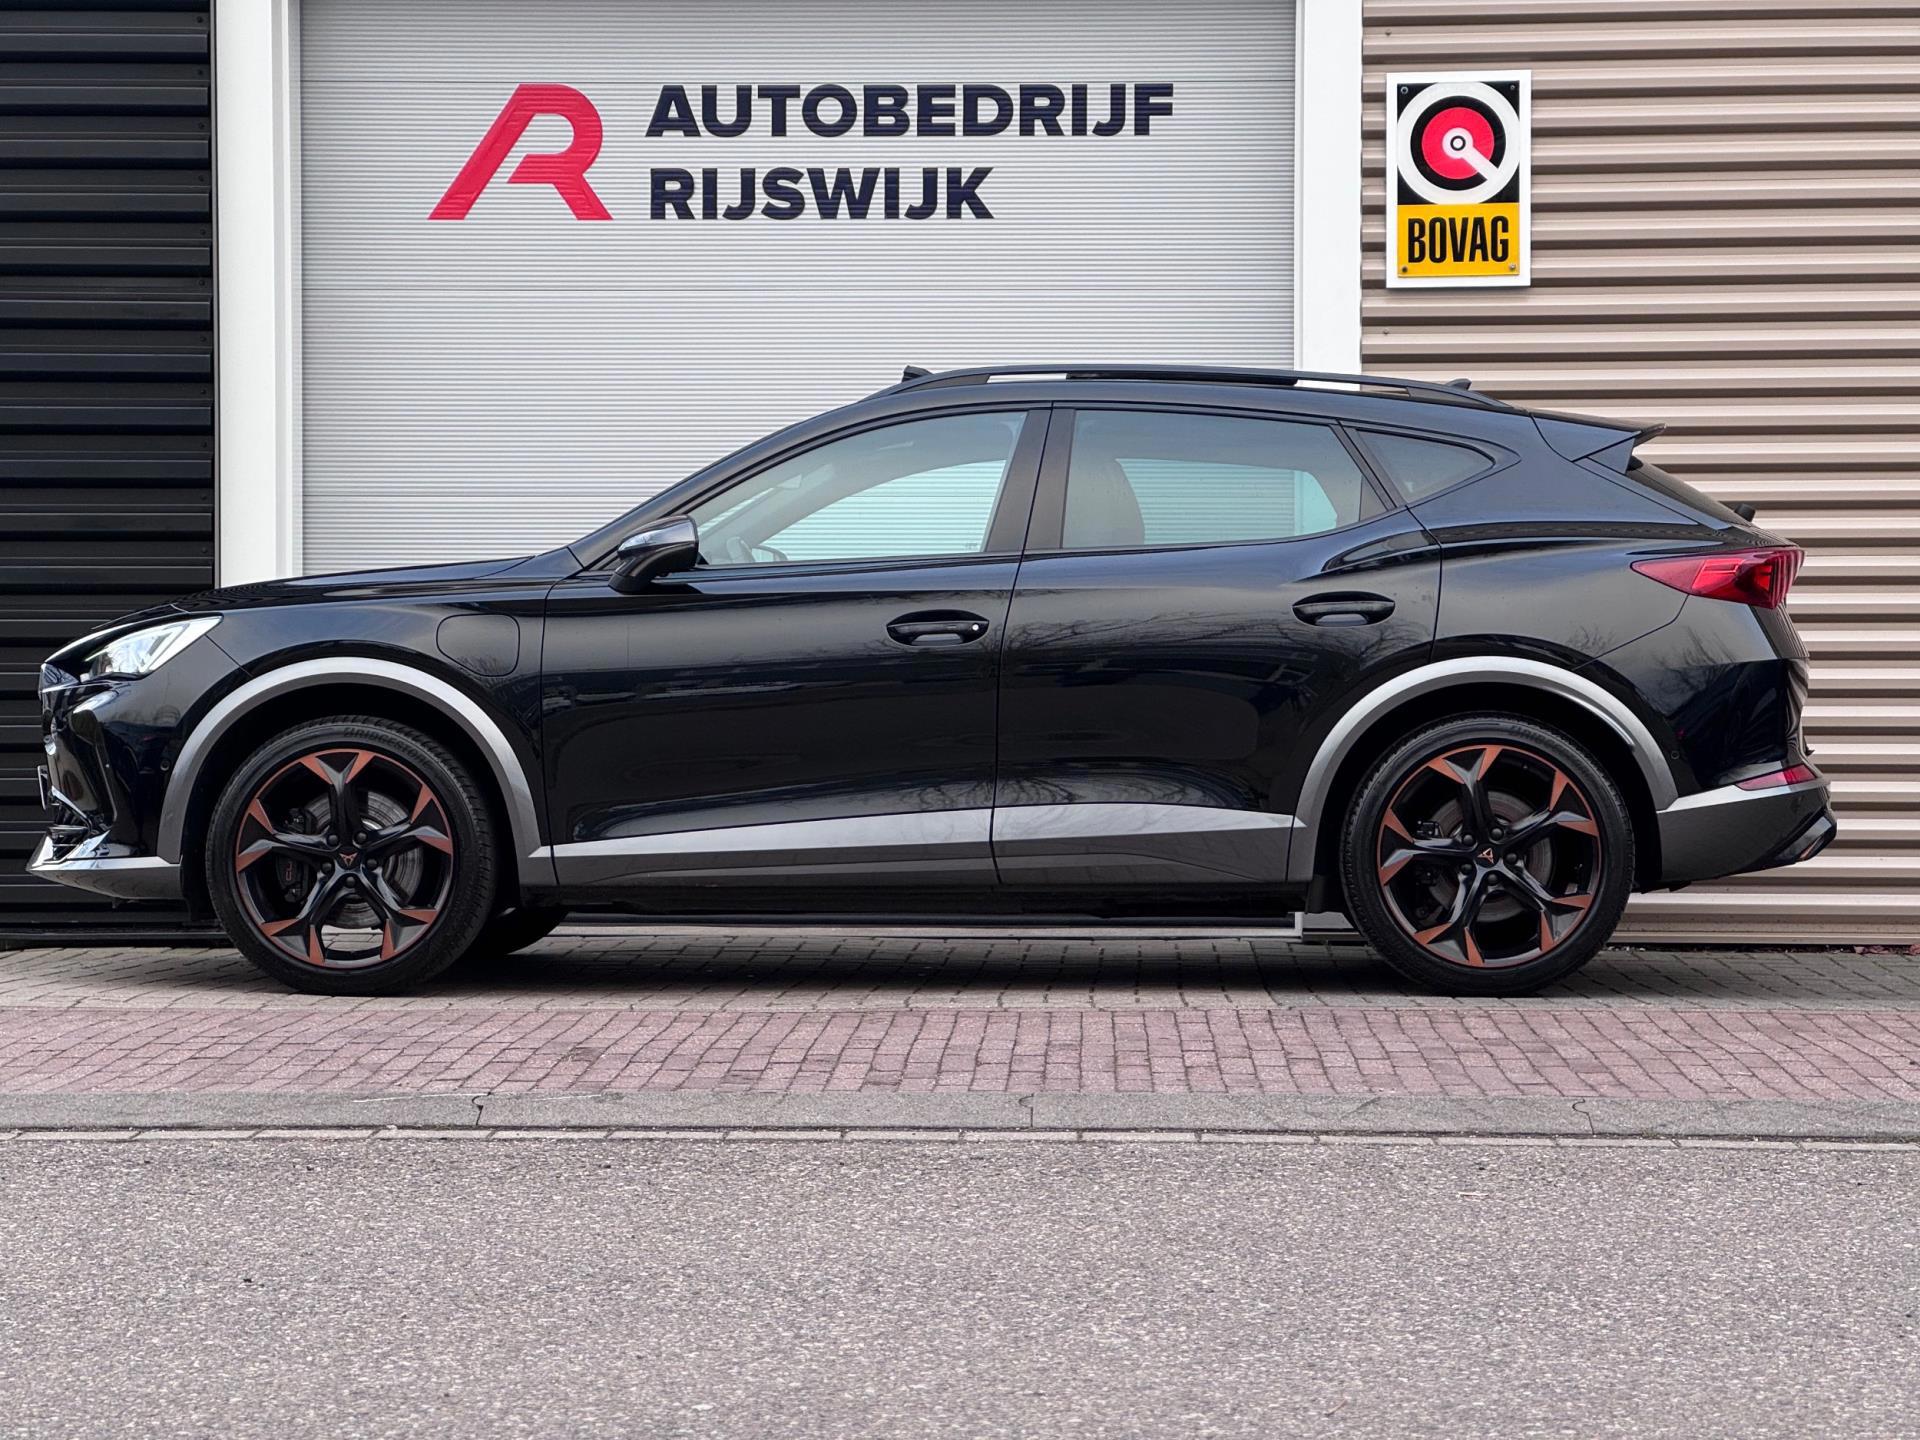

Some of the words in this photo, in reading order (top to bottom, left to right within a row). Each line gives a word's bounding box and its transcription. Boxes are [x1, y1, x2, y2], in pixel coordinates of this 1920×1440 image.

[646, 83, 1174, 138] AUTOBEDRIJF
[651, 167, 994, 221] RIJSWIJK
[1407, 215, 1509, 263] BOVAG
